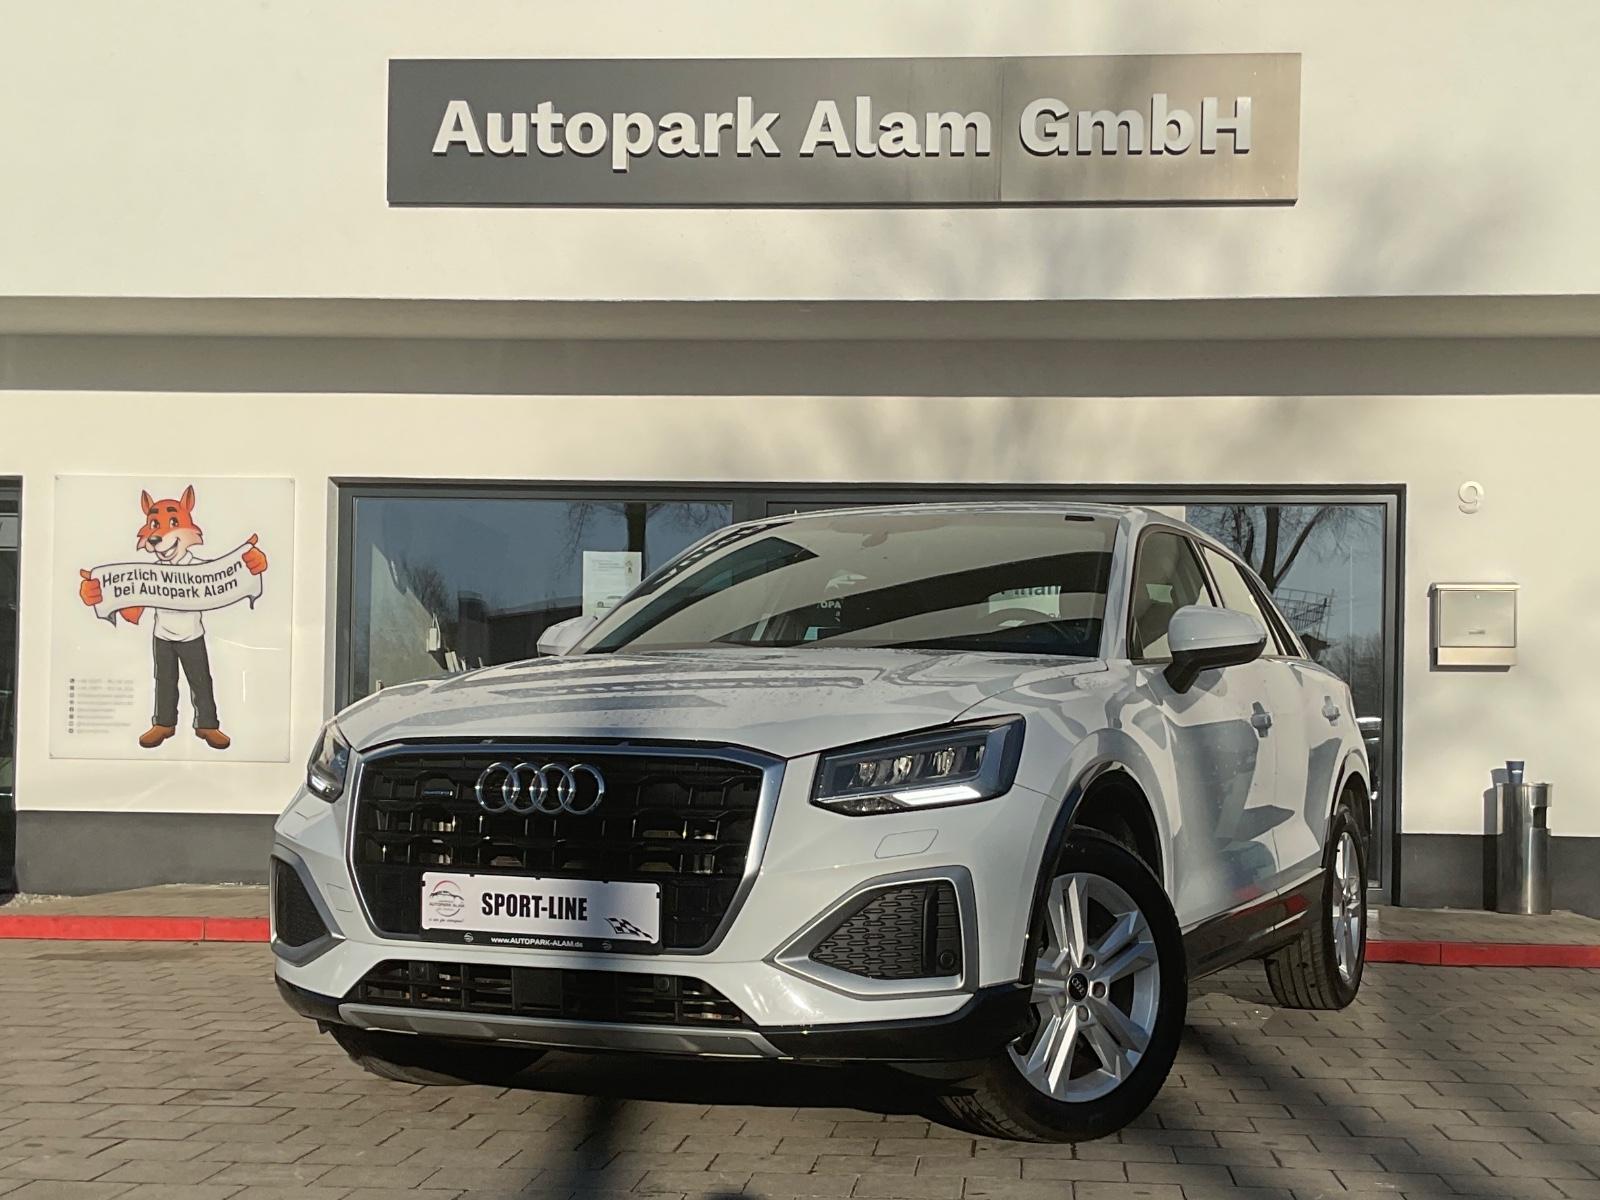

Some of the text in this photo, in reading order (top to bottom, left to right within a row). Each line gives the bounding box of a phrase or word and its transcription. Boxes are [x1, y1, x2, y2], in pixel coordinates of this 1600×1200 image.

[432, 93, 1252, 173] Autopark Alam GmbH
[1458, 480, 1484, 515] 9
[102, 560, 242, 588] Herzlich Willkommen
[114, 579, 238, 599] bei Autopark Alam
[481, 892, 588, 921] SPORT-LINE
